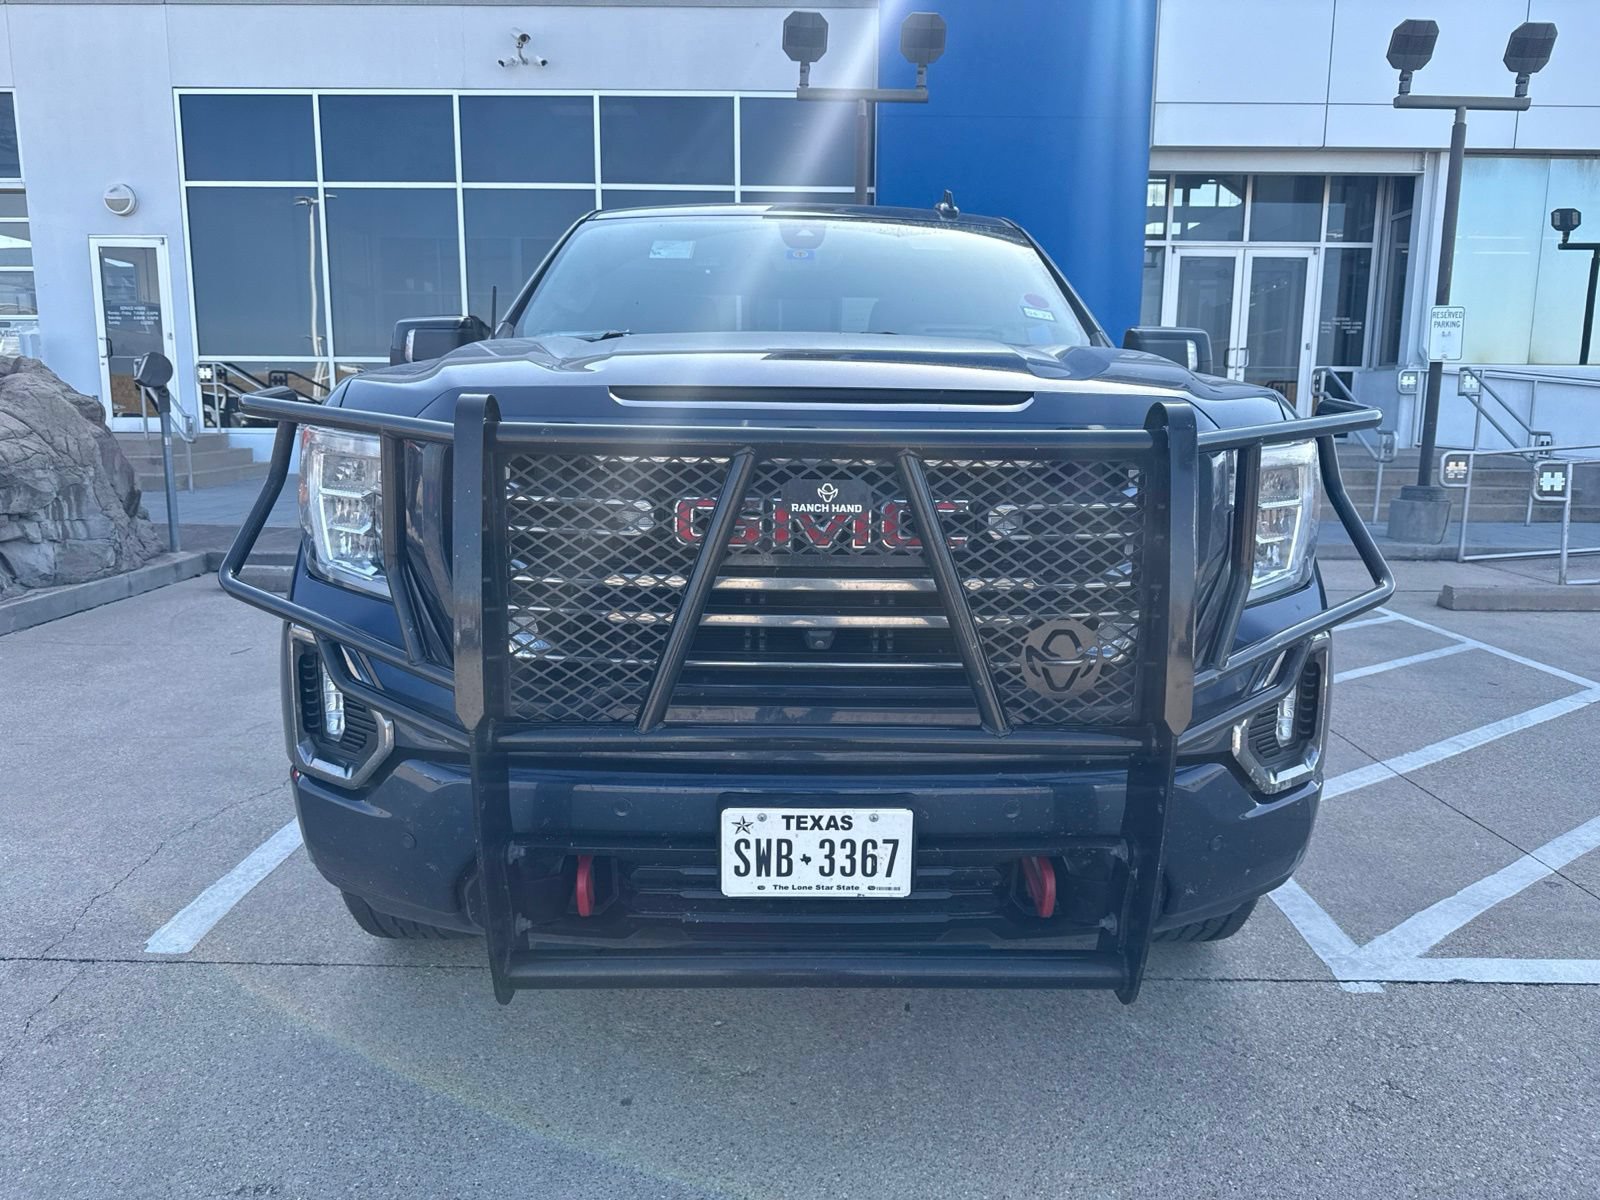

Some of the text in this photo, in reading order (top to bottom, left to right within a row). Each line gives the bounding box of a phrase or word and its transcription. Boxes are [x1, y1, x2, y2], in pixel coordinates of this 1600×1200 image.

[1432, 311, 1463, 319] RESERVED
[1433, 320, 1461, 328] PARKING
[791, 503, 862, 513] RANCH HAND
[675, 496, 969, 549] GMC
[781, 815, 853, 831] TEXAS
[734, 838, 900, 878] SWB 3367
